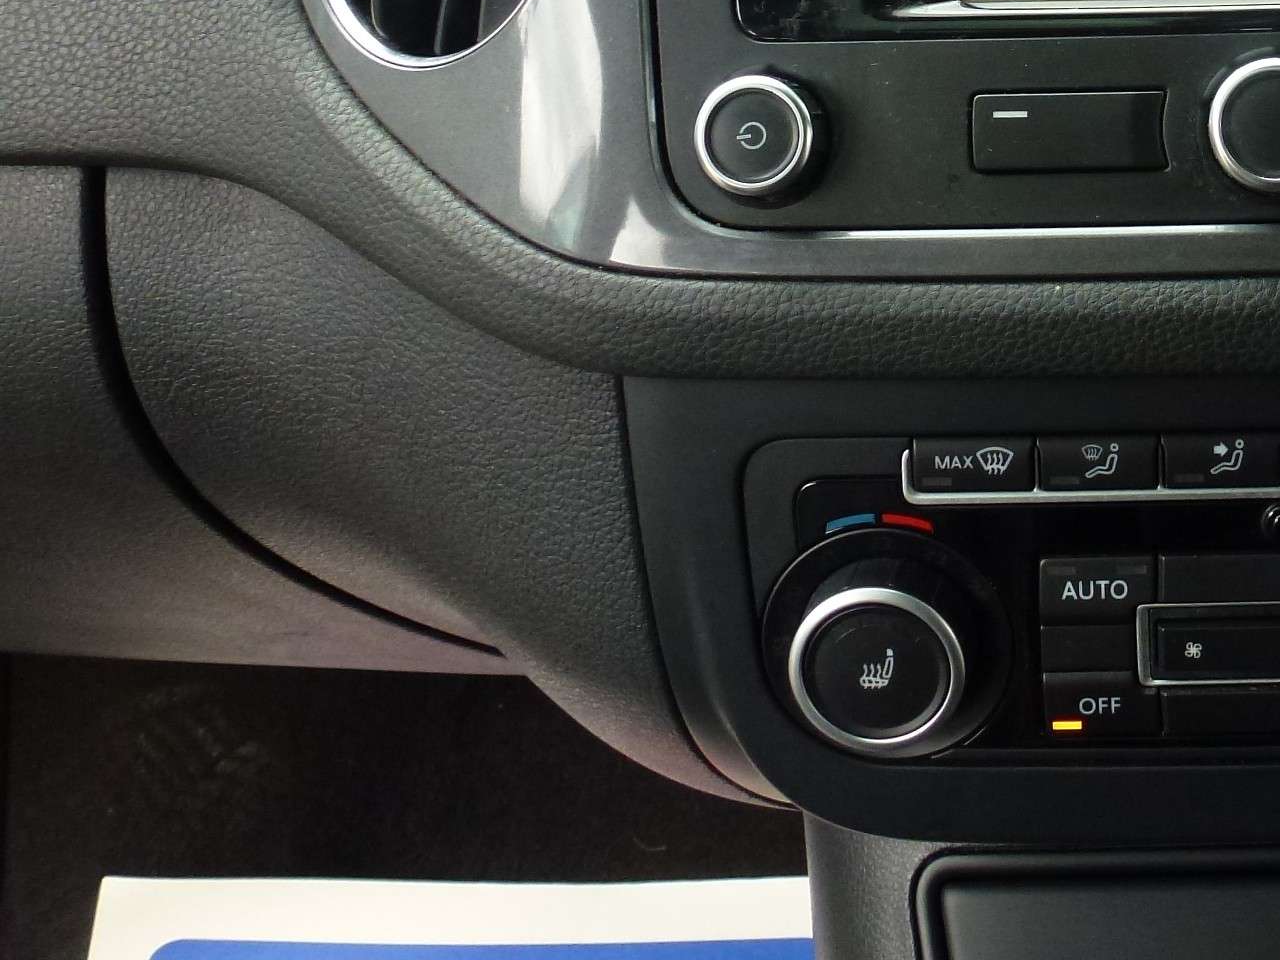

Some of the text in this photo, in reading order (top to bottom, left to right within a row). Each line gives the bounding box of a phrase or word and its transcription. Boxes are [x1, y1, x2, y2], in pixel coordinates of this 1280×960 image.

[934, 455, 974, 470] MAX
[1061, 579, 1129, 600] AUTO
[1078, 696, 1122, 715] OFF
